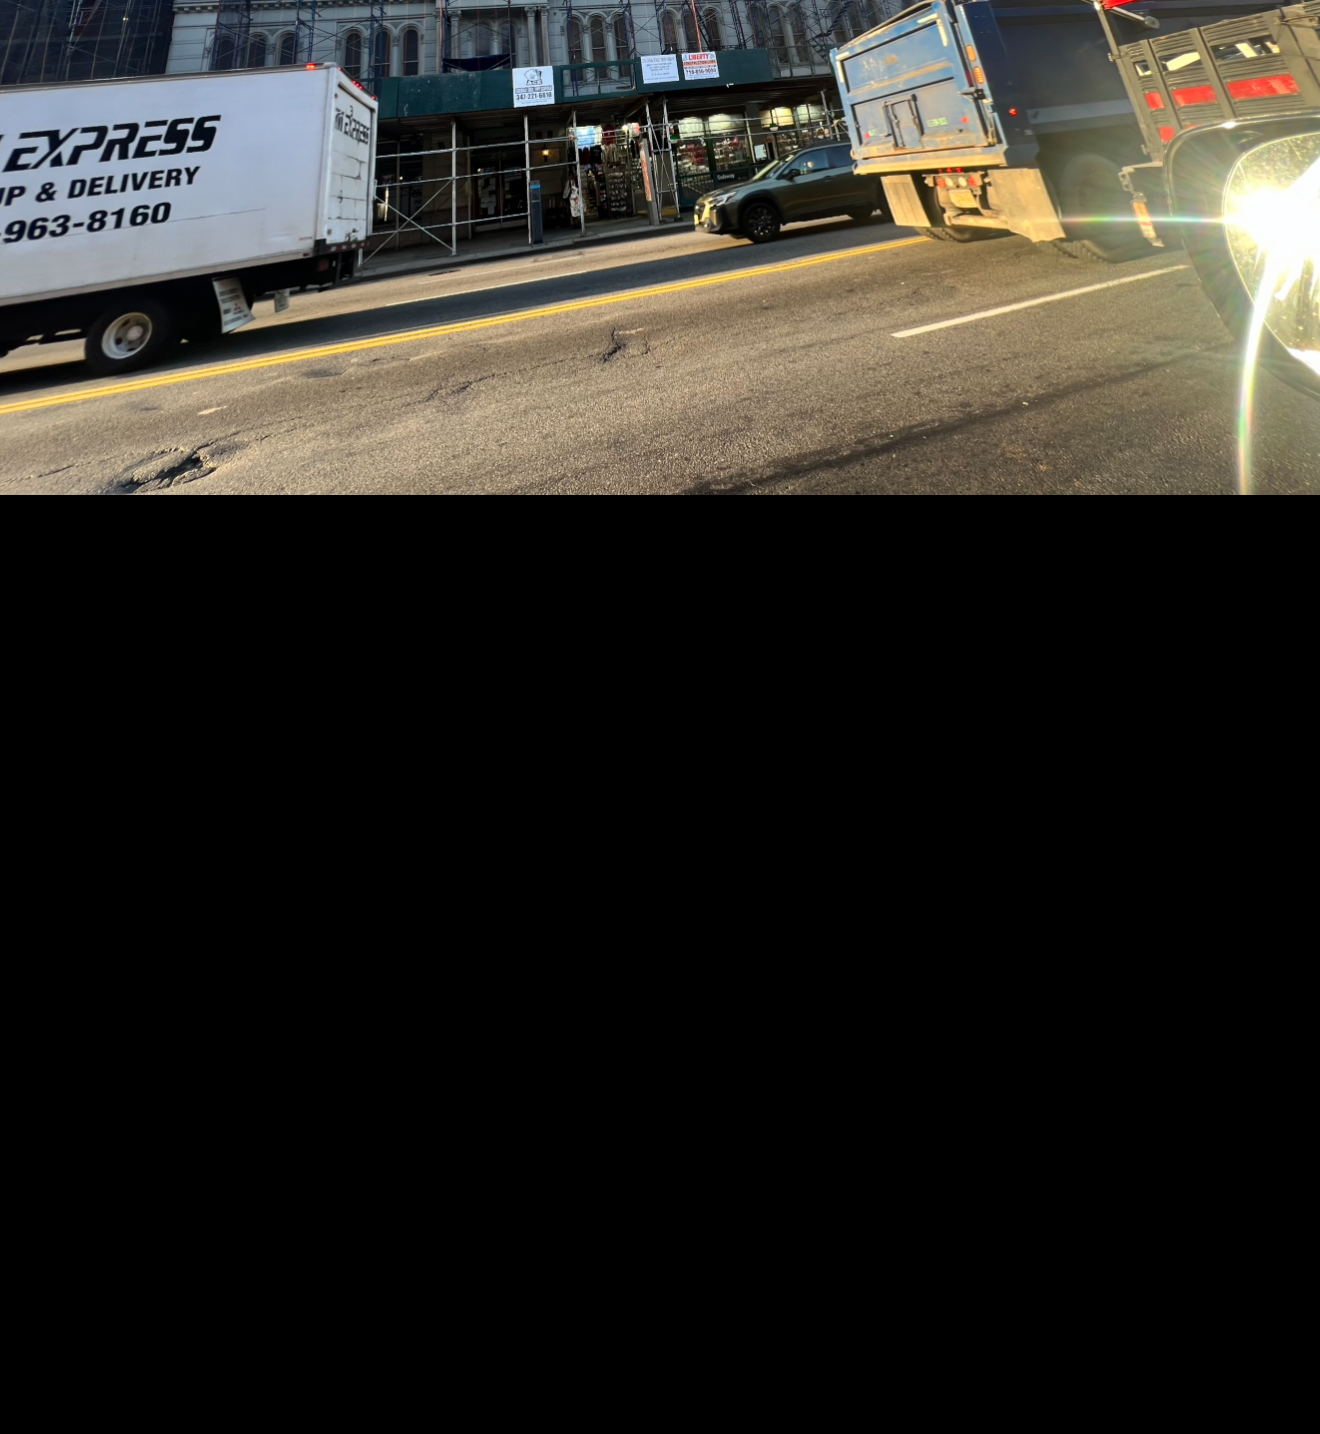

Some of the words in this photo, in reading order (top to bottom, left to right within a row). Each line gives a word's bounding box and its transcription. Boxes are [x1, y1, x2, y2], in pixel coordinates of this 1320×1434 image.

[2, 114, 222, 173] EXPRESS
[344, 114, 370, 145] EXPRESS
[35, 182, 57, 203] &
[67, 165, 201, 199] DELIVERY
[716, 173, 736, 181] Subway
